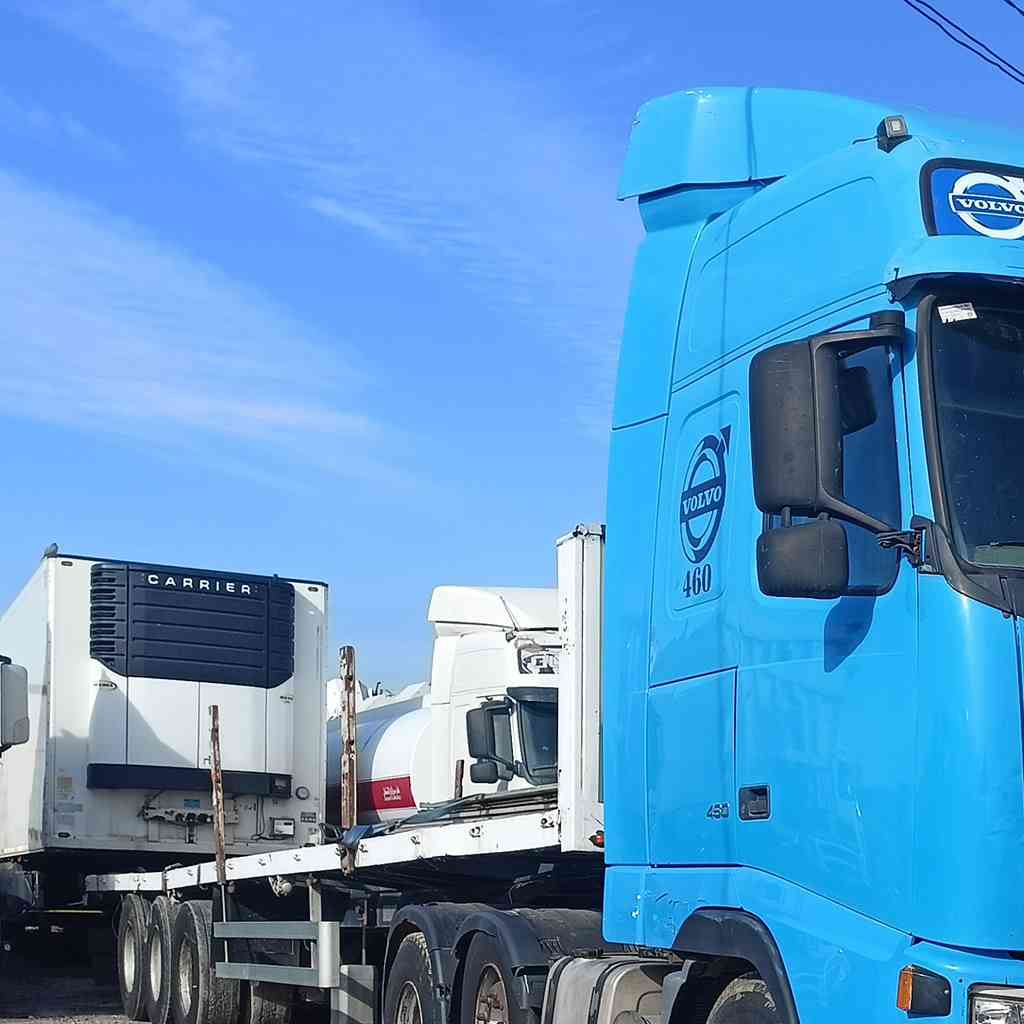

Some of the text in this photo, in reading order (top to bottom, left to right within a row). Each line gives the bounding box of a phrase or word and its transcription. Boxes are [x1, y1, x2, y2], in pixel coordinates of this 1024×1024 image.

[682, 486, 722, 515] VOLVO
[147, 574, 251, 595] CARRIER
[682, 563, 712, 598] 460
